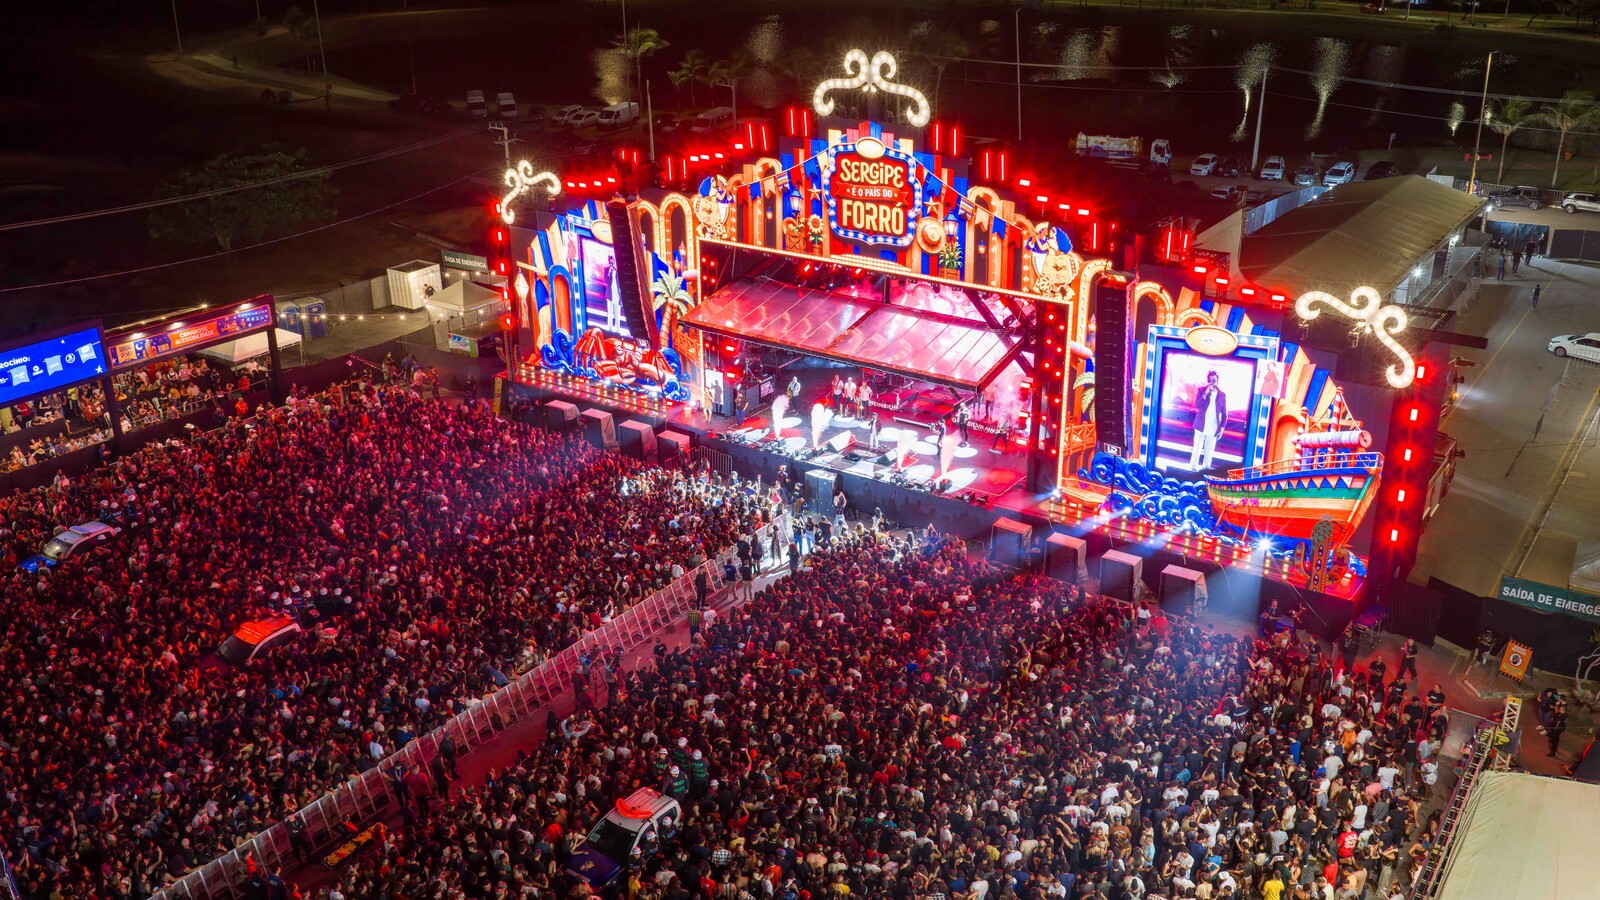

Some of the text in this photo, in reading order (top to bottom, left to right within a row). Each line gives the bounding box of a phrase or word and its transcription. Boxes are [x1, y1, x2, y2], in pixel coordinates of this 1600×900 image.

[840, 158, 904, 188] SERGIPE
[851, 185, 893, 198] É O PAÍS DO
[841, 199, 904, 235] FORRÓ
[1502, 586, 1535, 602] SAÍDA
[1538, 594, 1553, 605] DE
